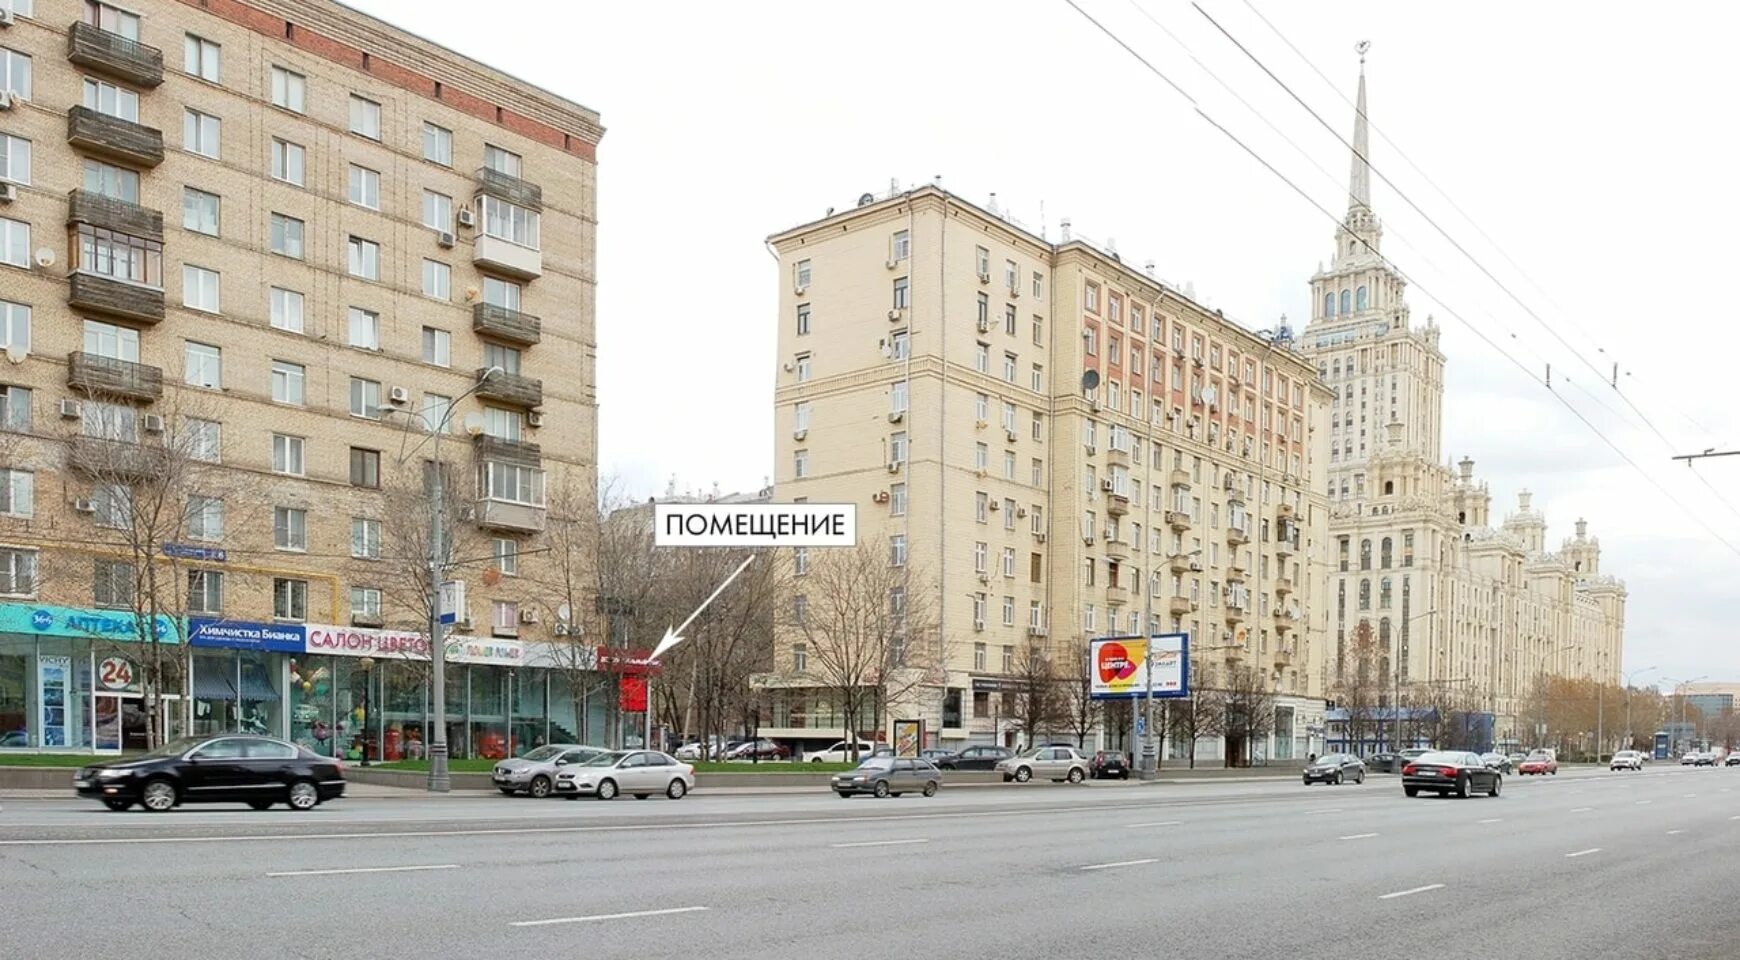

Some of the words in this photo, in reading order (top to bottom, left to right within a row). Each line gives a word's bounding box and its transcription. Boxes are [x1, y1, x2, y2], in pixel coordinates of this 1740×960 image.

[65, 615, 137, 634] АПТЕКА
[199, 624, 260, 639] Химчистка
[261, 629, 300, 641] Бианка
[310, 630, 372, 650] САЛОН
[378, 635, 433, 654] ЦВЕТО
[101, 661, 131, 683] 24
